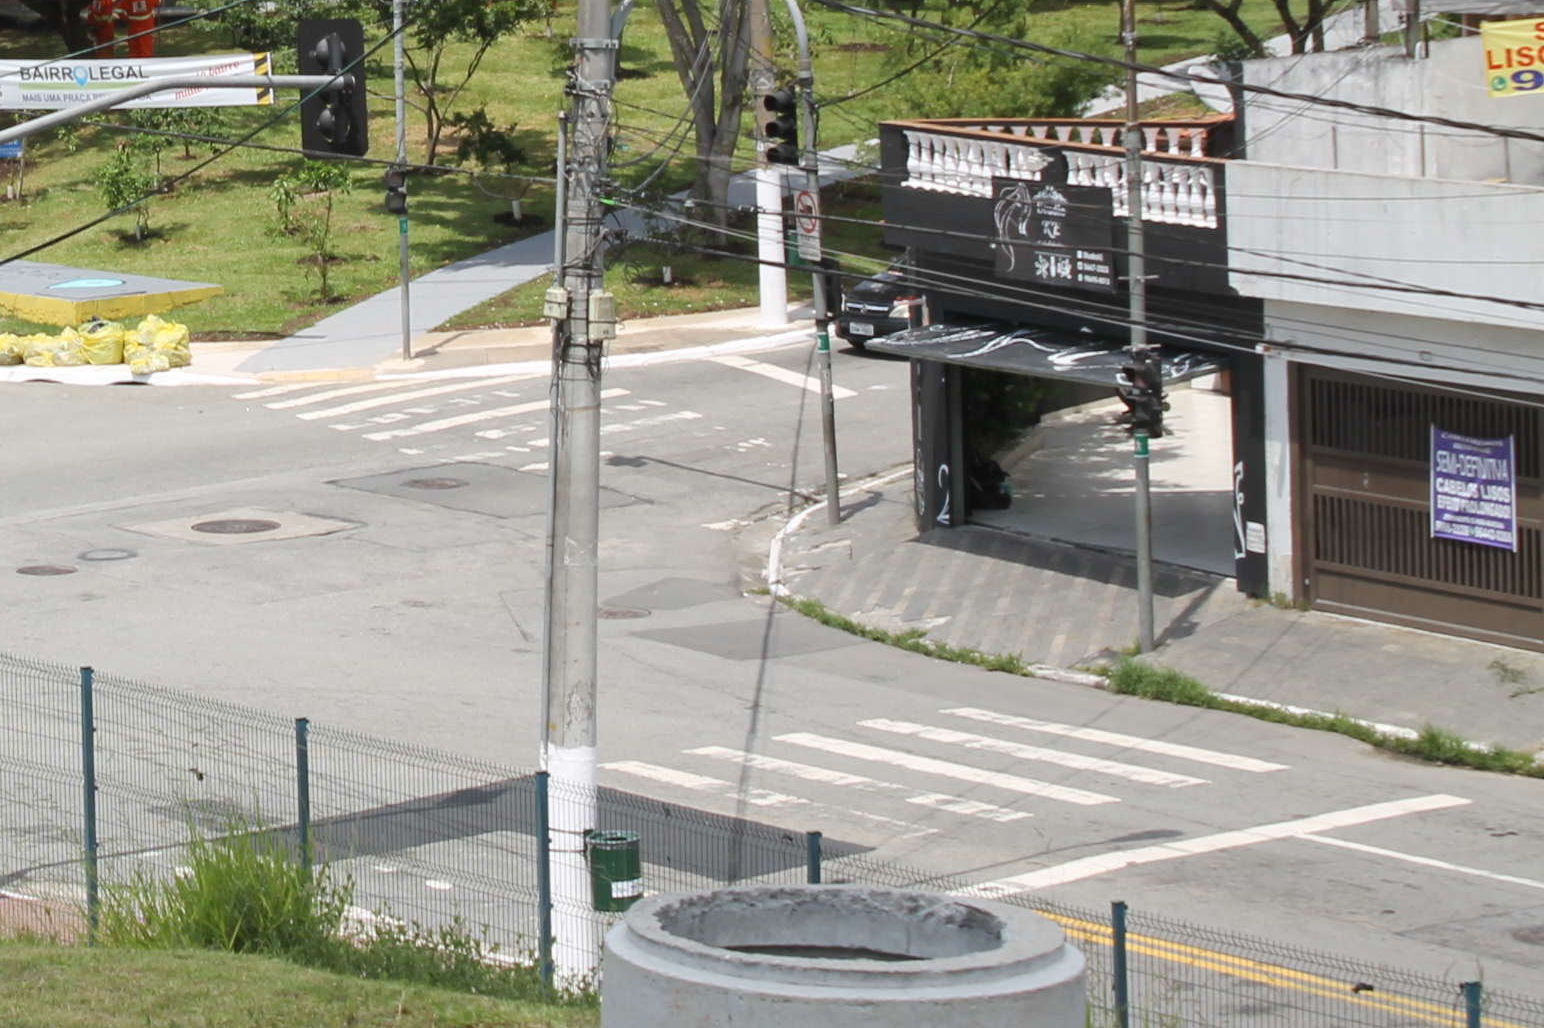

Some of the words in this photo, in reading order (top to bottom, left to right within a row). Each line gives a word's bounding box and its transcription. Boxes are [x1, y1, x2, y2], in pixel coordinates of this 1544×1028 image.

[89, 65, 149, 81] LEGAL
[22, 94, 42, 103] MAIS
[43, 94, 61, 103] UMA
[1436, 477, 1479, 499] CABELOS
[1480, 483, 1511, 503] LISOS
